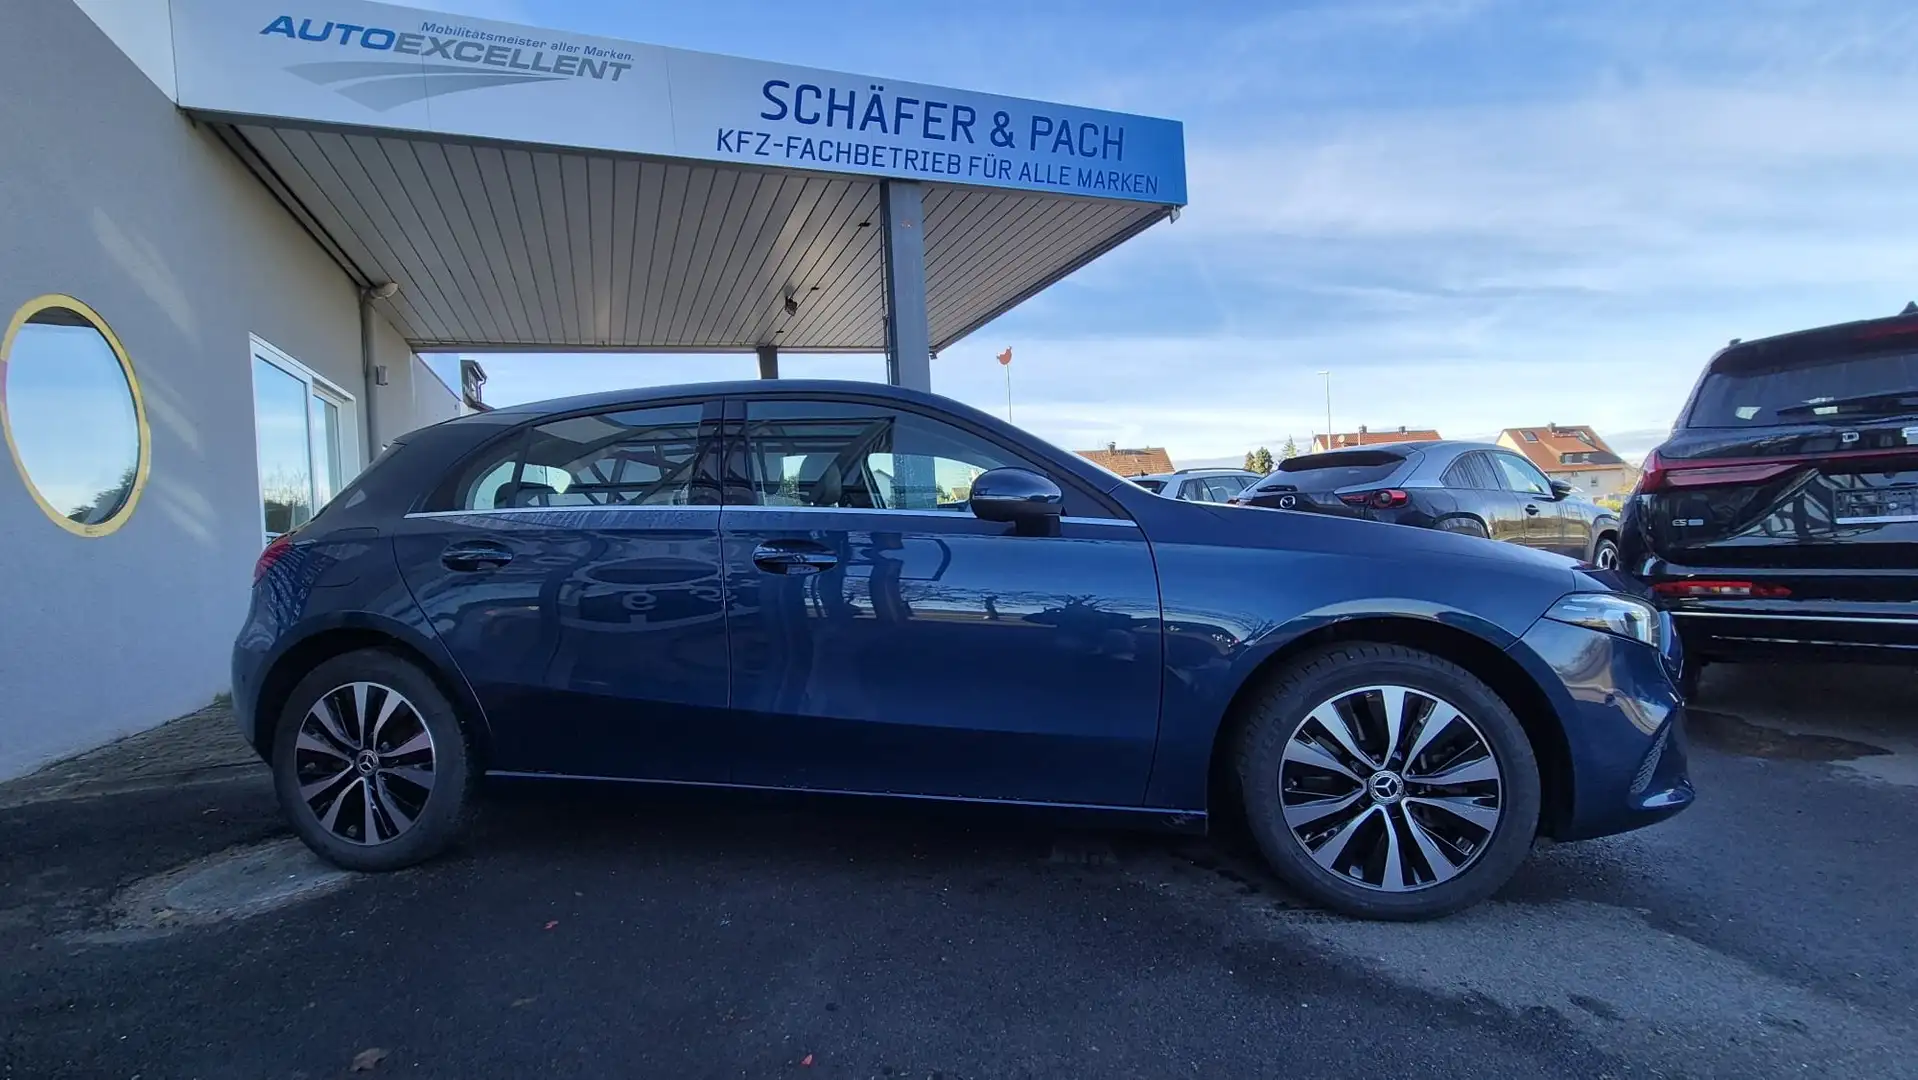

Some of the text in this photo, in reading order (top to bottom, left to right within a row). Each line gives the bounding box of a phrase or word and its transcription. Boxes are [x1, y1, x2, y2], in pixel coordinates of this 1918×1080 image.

[550, 41, 581, 54] aller
[583, 45, 635, 61] Marken.
[760, 79, 1125, 161] SCHÄFER & PACH
[716, 128, 1158, 195] KFZ-FACHBETRIEB FÜR ALLE MARKEN
